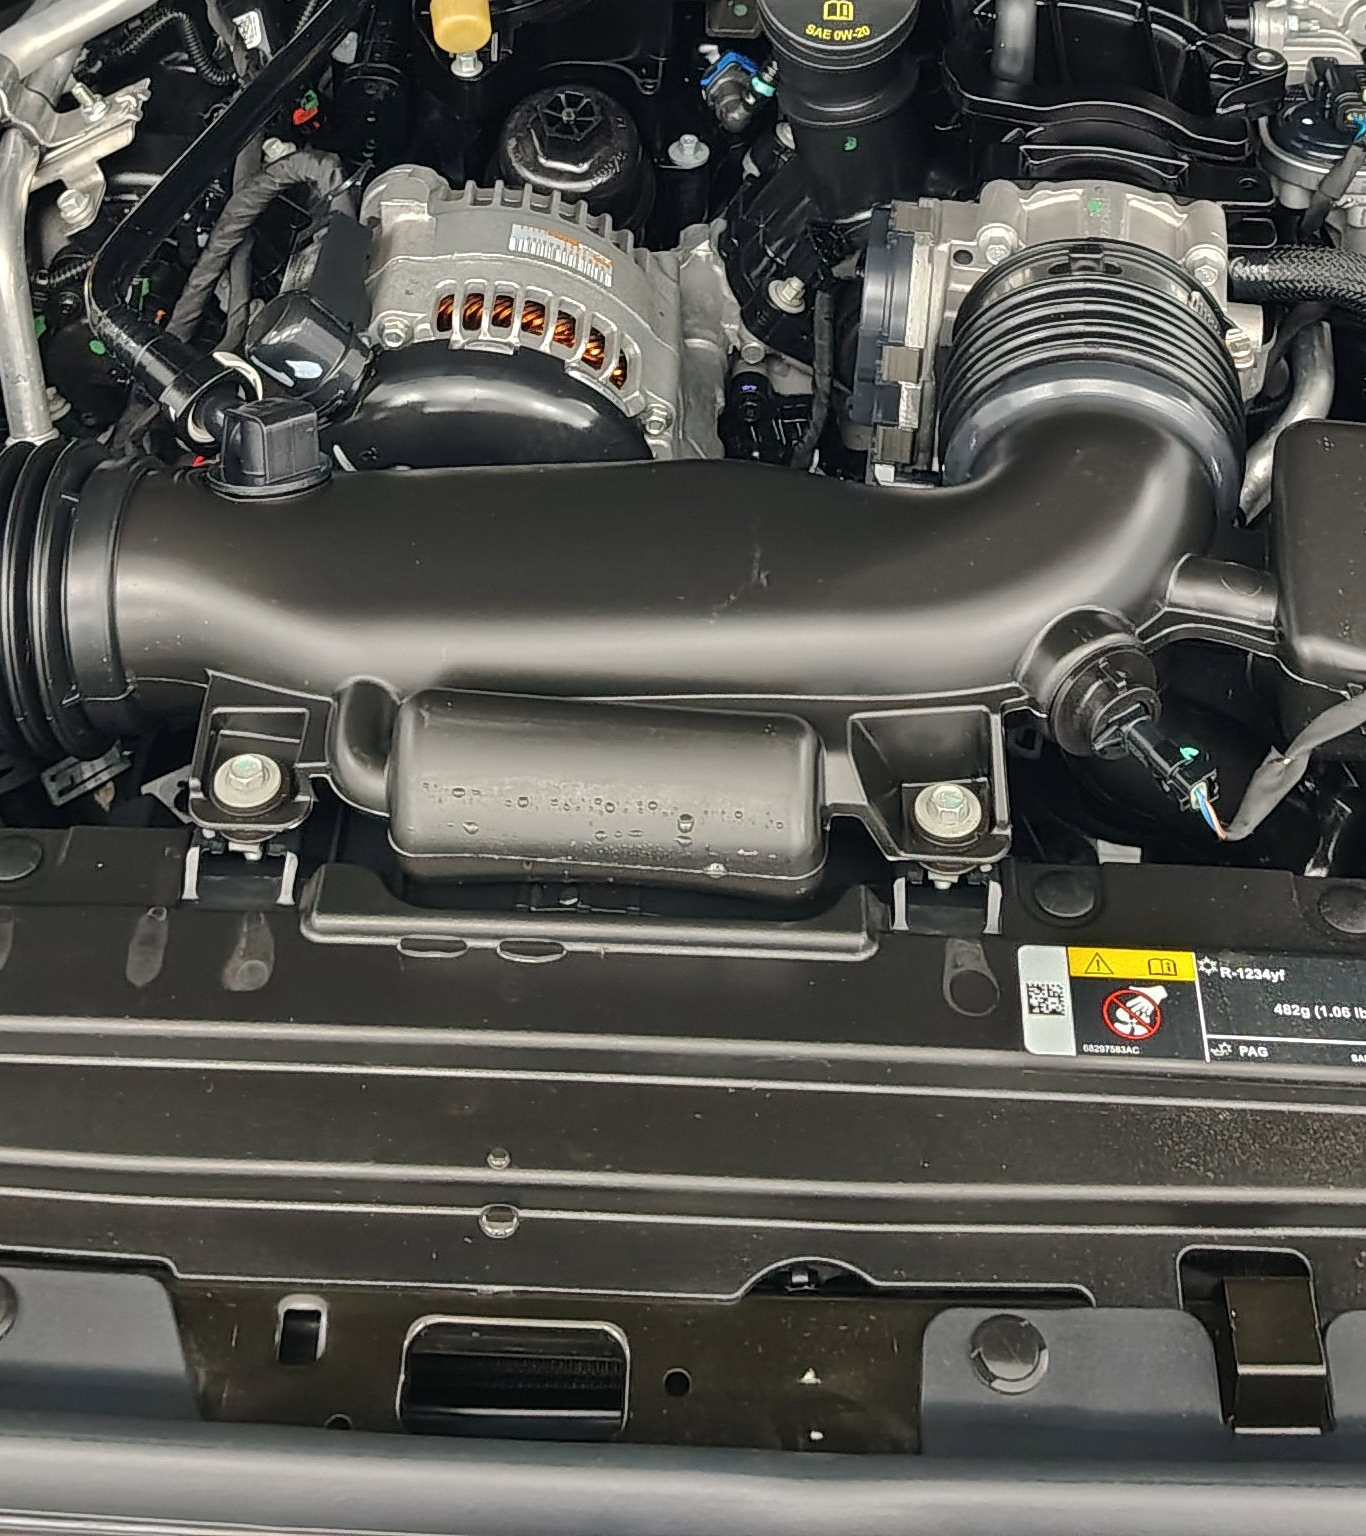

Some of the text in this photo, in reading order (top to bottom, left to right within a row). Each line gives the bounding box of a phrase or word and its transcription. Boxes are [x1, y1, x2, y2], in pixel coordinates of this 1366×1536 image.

[805, 23, 871, 41] SAE 0W-20
[1219, 966, 1286, 983] R-1234yf
[1273, 1003, 1311, 1019] 482g
[1314, 1004, 1352, 1020] (1.06
[1238, 1045, 1269, 1058] PAG
